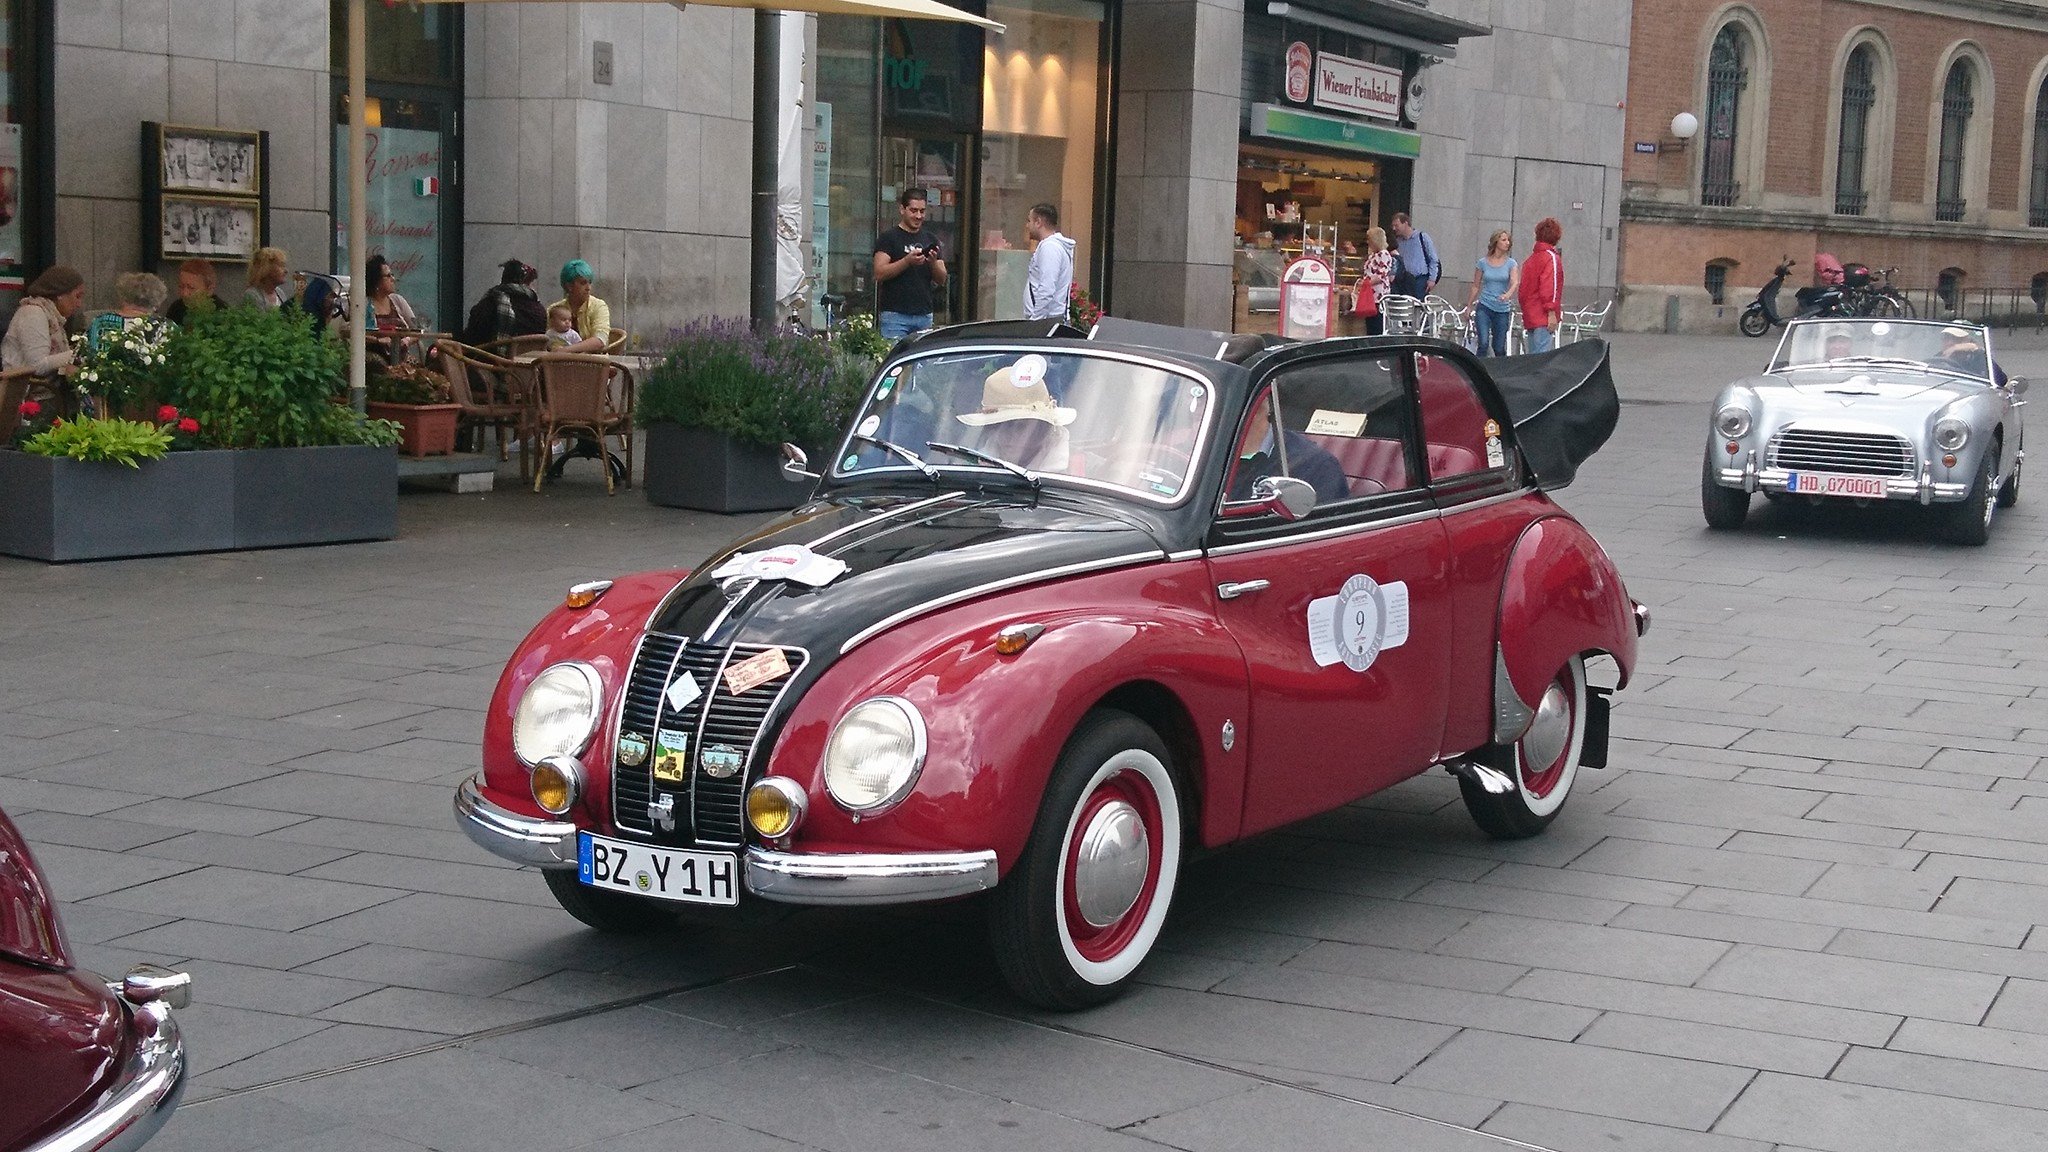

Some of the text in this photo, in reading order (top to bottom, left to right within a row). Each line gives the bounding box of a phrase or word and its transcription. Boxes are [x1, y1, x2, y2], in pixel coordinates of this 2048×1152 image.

[598, 60, 610, 77] 24
[1322, 69, 1396, 105] Wiener Feinbäcker
[1314, 418, 1339, 426] ATLAS
[1800, 475, 1882, 495] HD 070001
[1356, 610, 1365, 636] 9
[583, 863, 589, 875] D
[593, 843, 630, 886] BZ
[651, 854, 671, 892] Y
